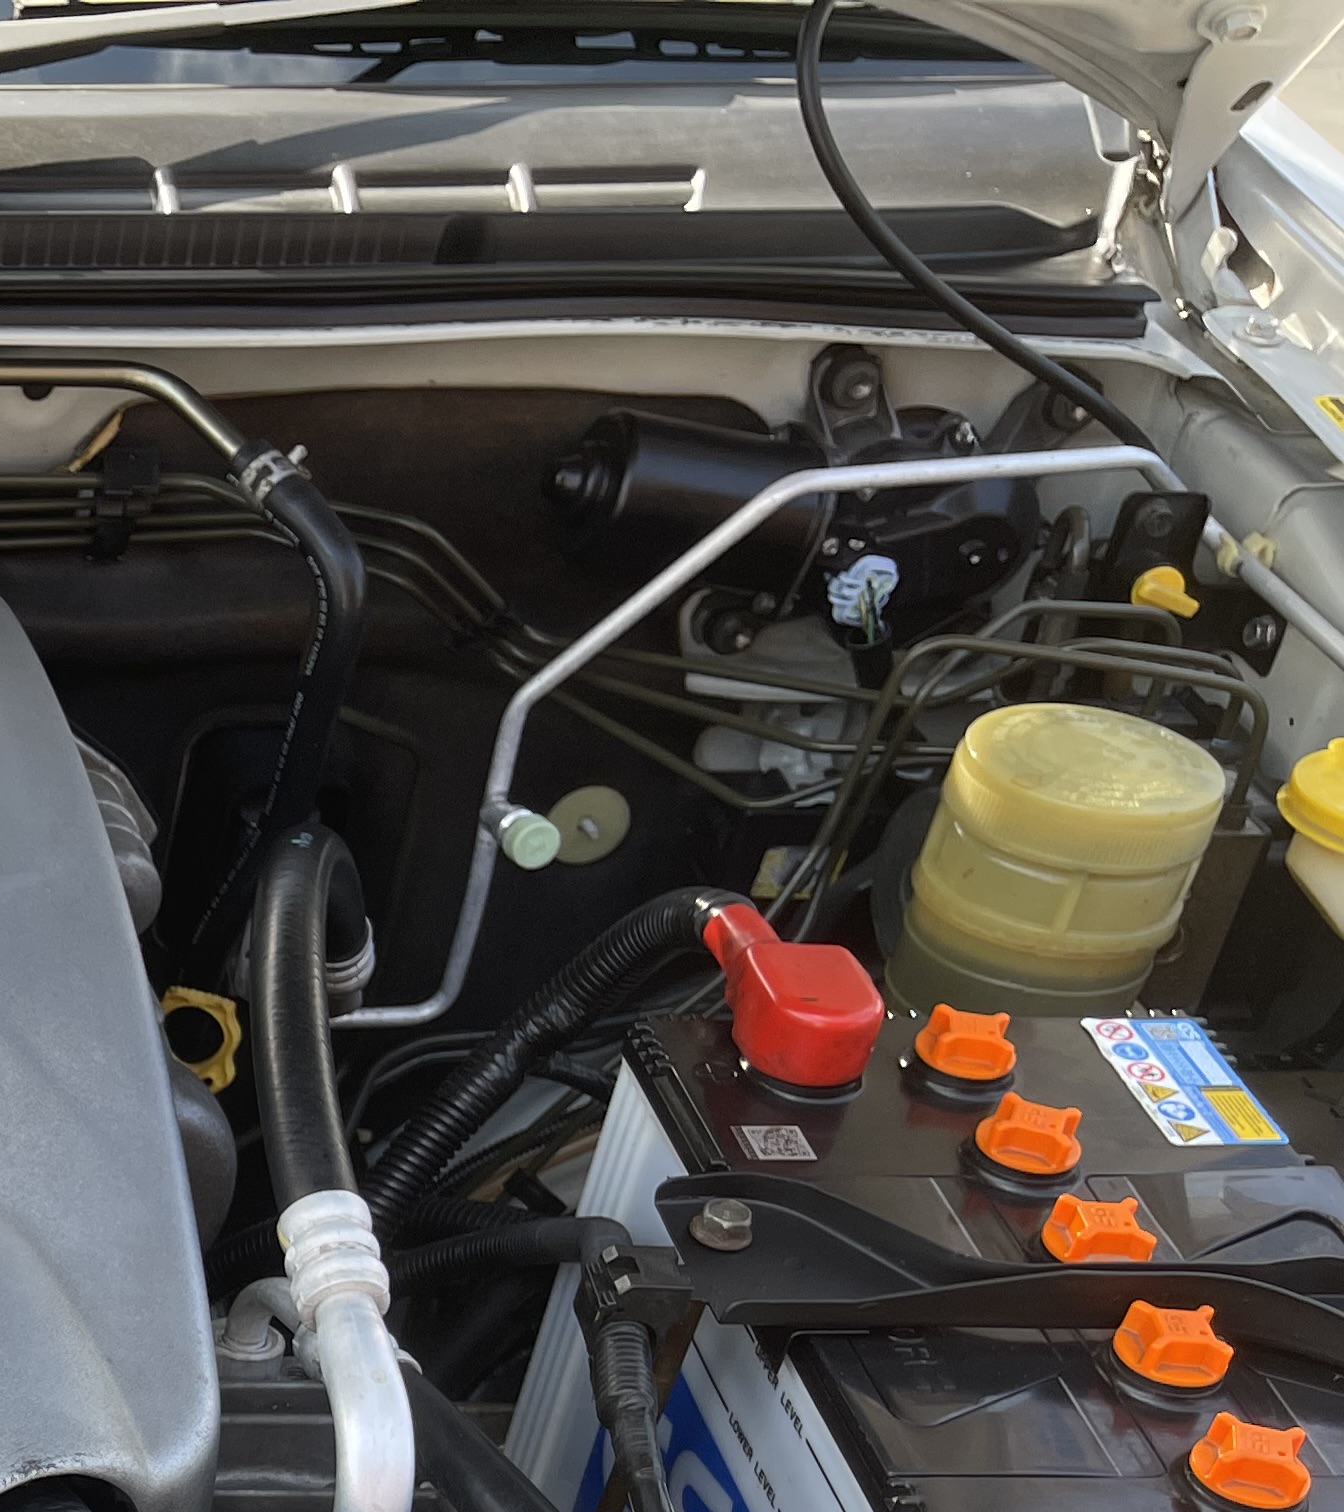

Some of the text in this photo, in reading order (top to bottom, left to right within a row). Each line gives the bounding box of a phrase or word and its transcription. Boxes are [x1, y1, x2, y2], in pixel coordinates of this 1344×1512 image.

[780, 1391, 804, 1440] LEVEL
[728, 1411, 777, 1510] LOWER LEVEL
